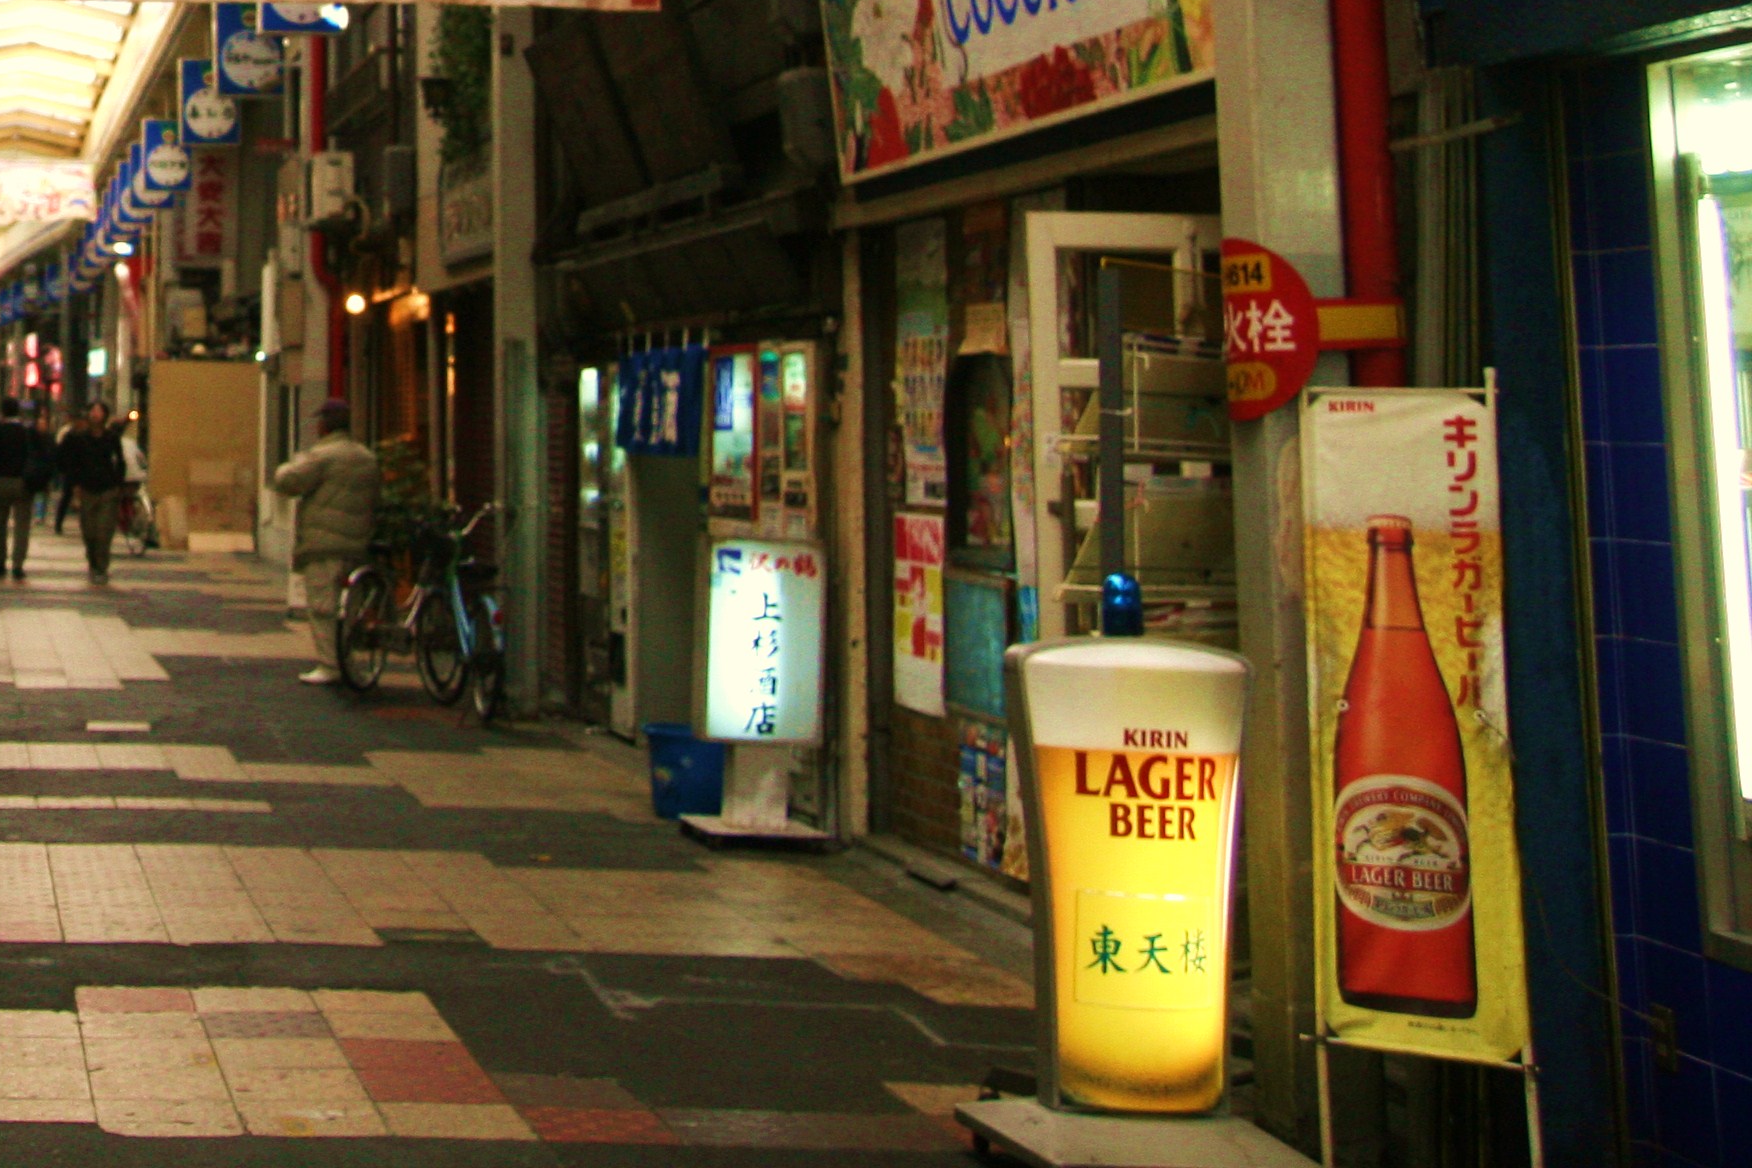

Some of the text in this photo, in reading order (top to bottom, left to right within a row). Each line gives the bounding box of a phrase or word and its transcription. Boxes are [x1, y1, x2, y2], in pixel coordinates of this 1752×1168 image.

[1224, 261, 1264, 287] 614
[1327, 399, 1375, 415] KIRIN
[1442, 414, 1484, 709] キリンラガービール
[744, 591, 784, 736] 上杉酒店
[1123, 728, 1189, 749] KIRIN
[1074, 750, 1217, 801] LAGER
[1109, 802, 1197, 841] BEER
[1351, 864, 1454, 893] LAGER BEER
[1084, 923, 1207, 975] 東天楼
